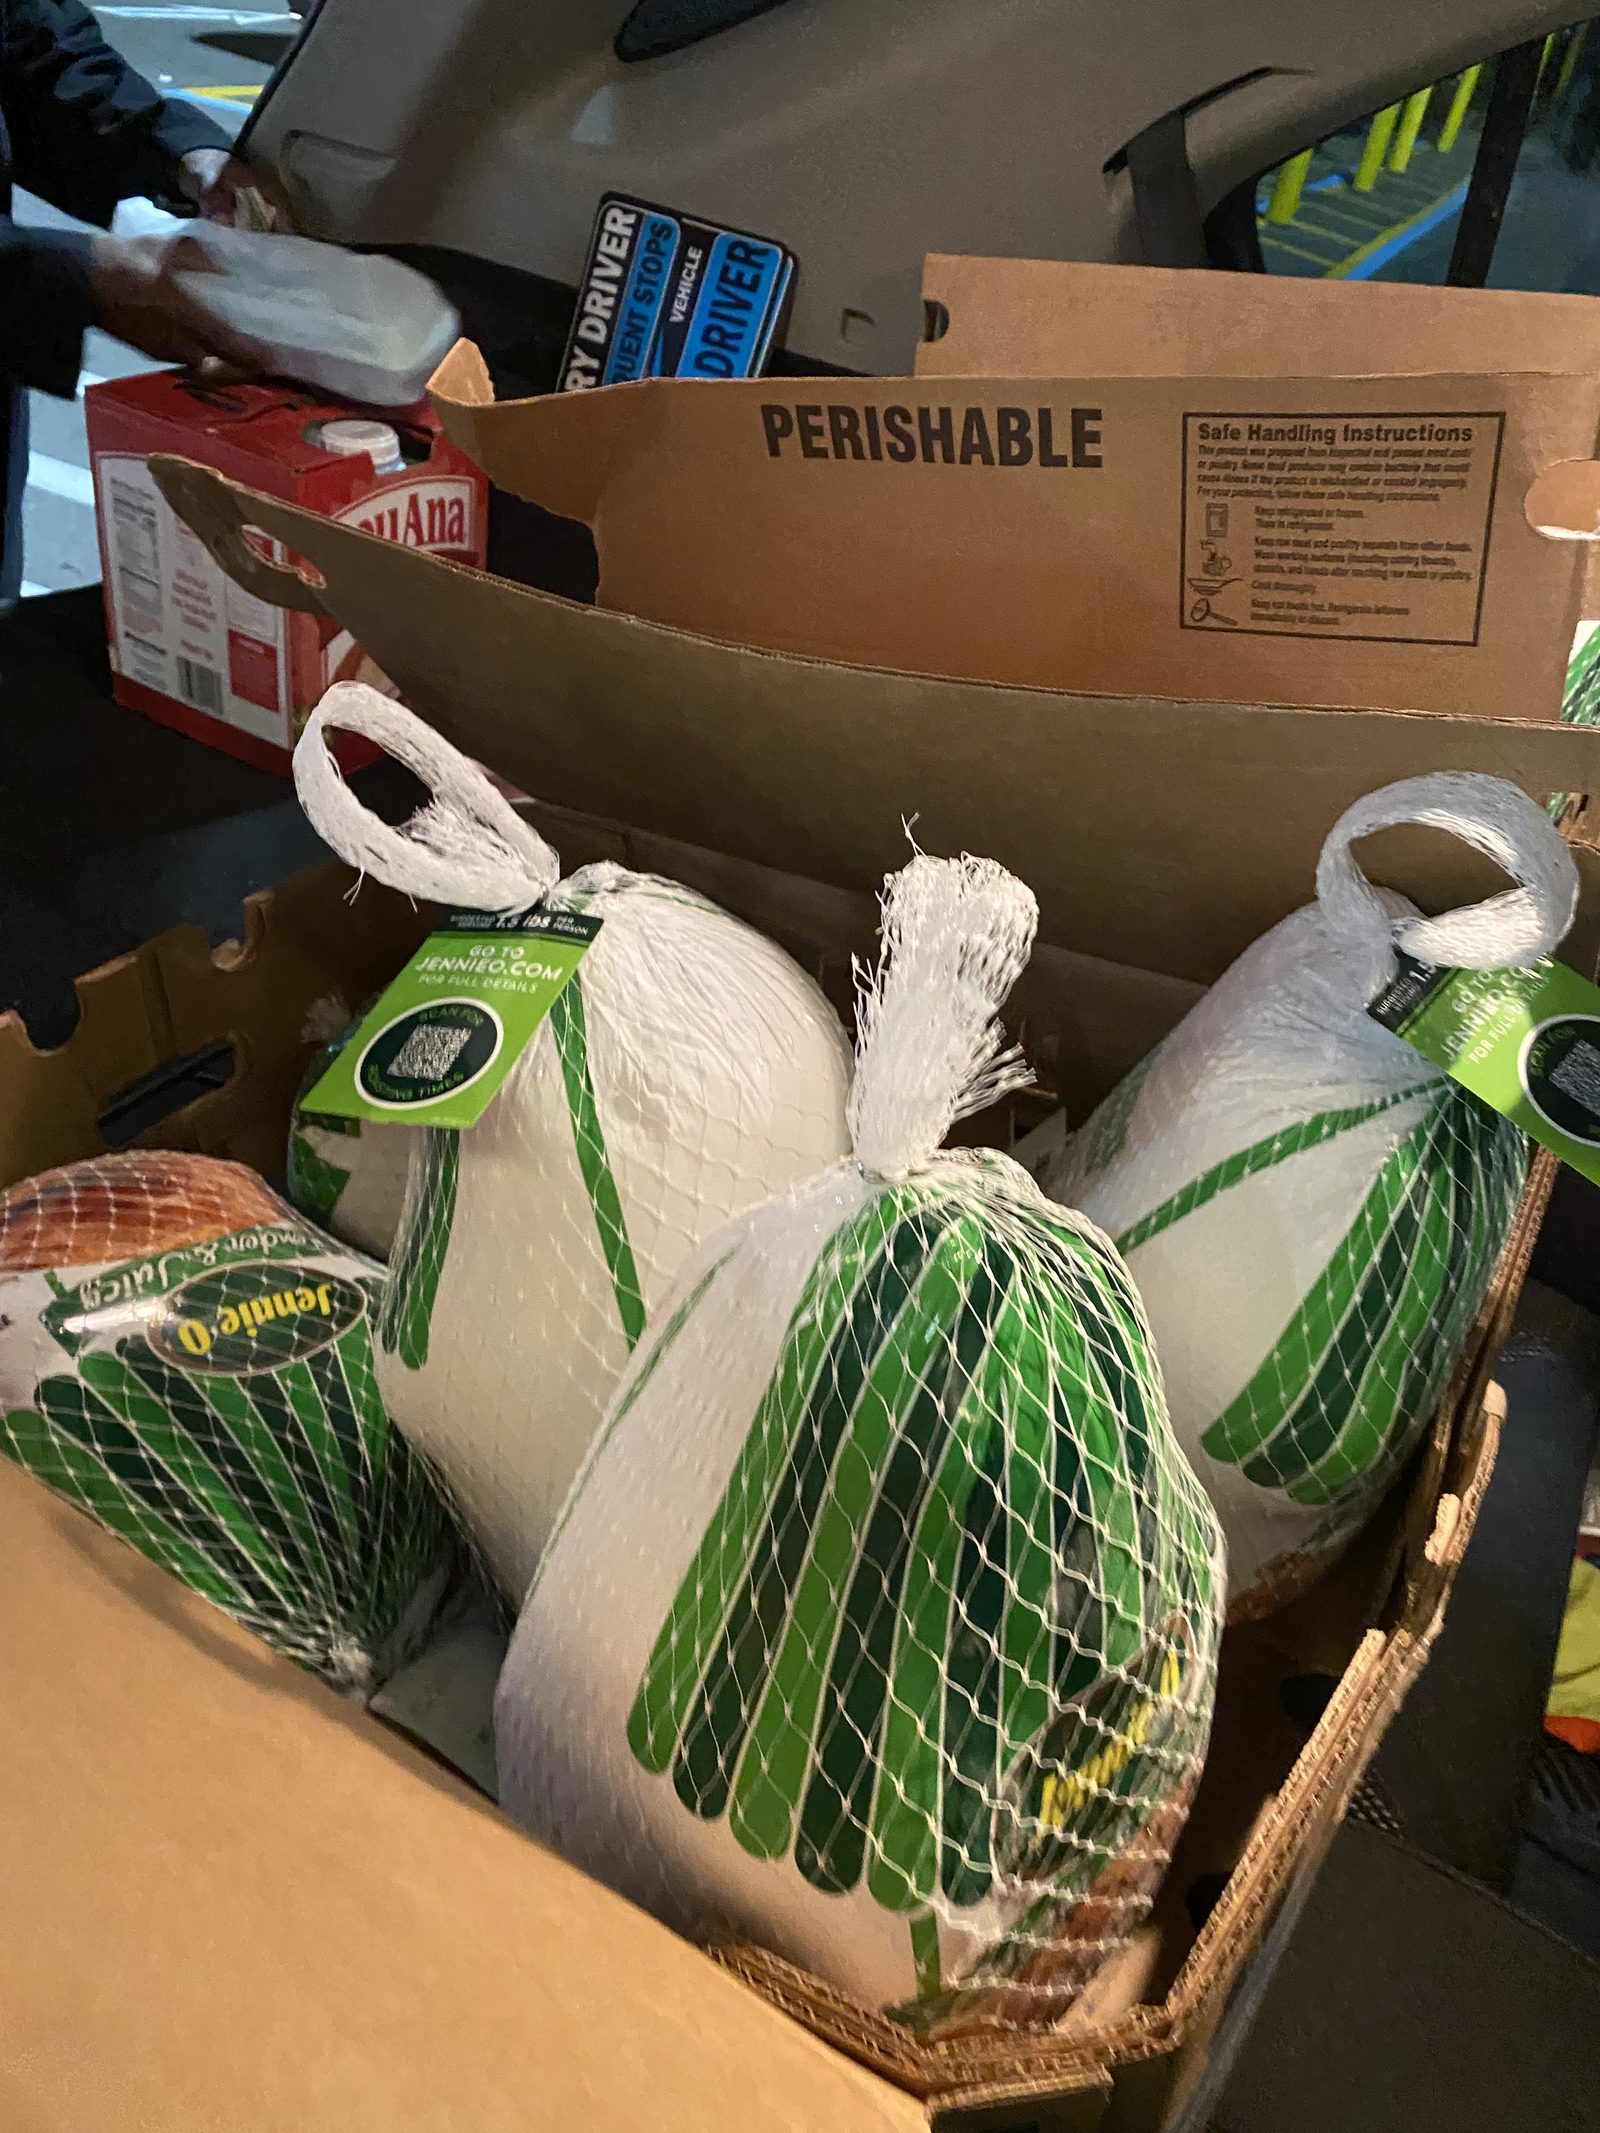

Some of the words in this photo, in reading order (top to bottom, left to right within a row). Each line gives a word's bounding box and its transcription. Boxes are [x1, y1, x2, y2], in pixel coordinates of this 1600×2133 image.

[578, 207, 637, 344] DRIVER
[633, 221, 673, 307] STOPS
[669, 246, 702, 323] VEHICLE
[694, 240, 770, 377] DRIVER
[761, 404, 1102, 467] PERISHABLE
[1198, 423, 1240, 440] Safe
[1248, 423, 1335, 445] Handling
[1343, 423, 1472, 441] Instructions
[358, 492, 464, 546] uAna
[415, 956, 562, 981] JENNIEO.COM
[469, 945, 495, 957] GO
[501, 946, 525, 960] TO
[1452, 990, 1475, 1013] GO
[1468, 1040, 1495, 1064] FOR
[79, 1251, 190, 1310] Juicy
[178, 1318, 211, 1355] O
[218, 1282, 332, 1338] Jennie
